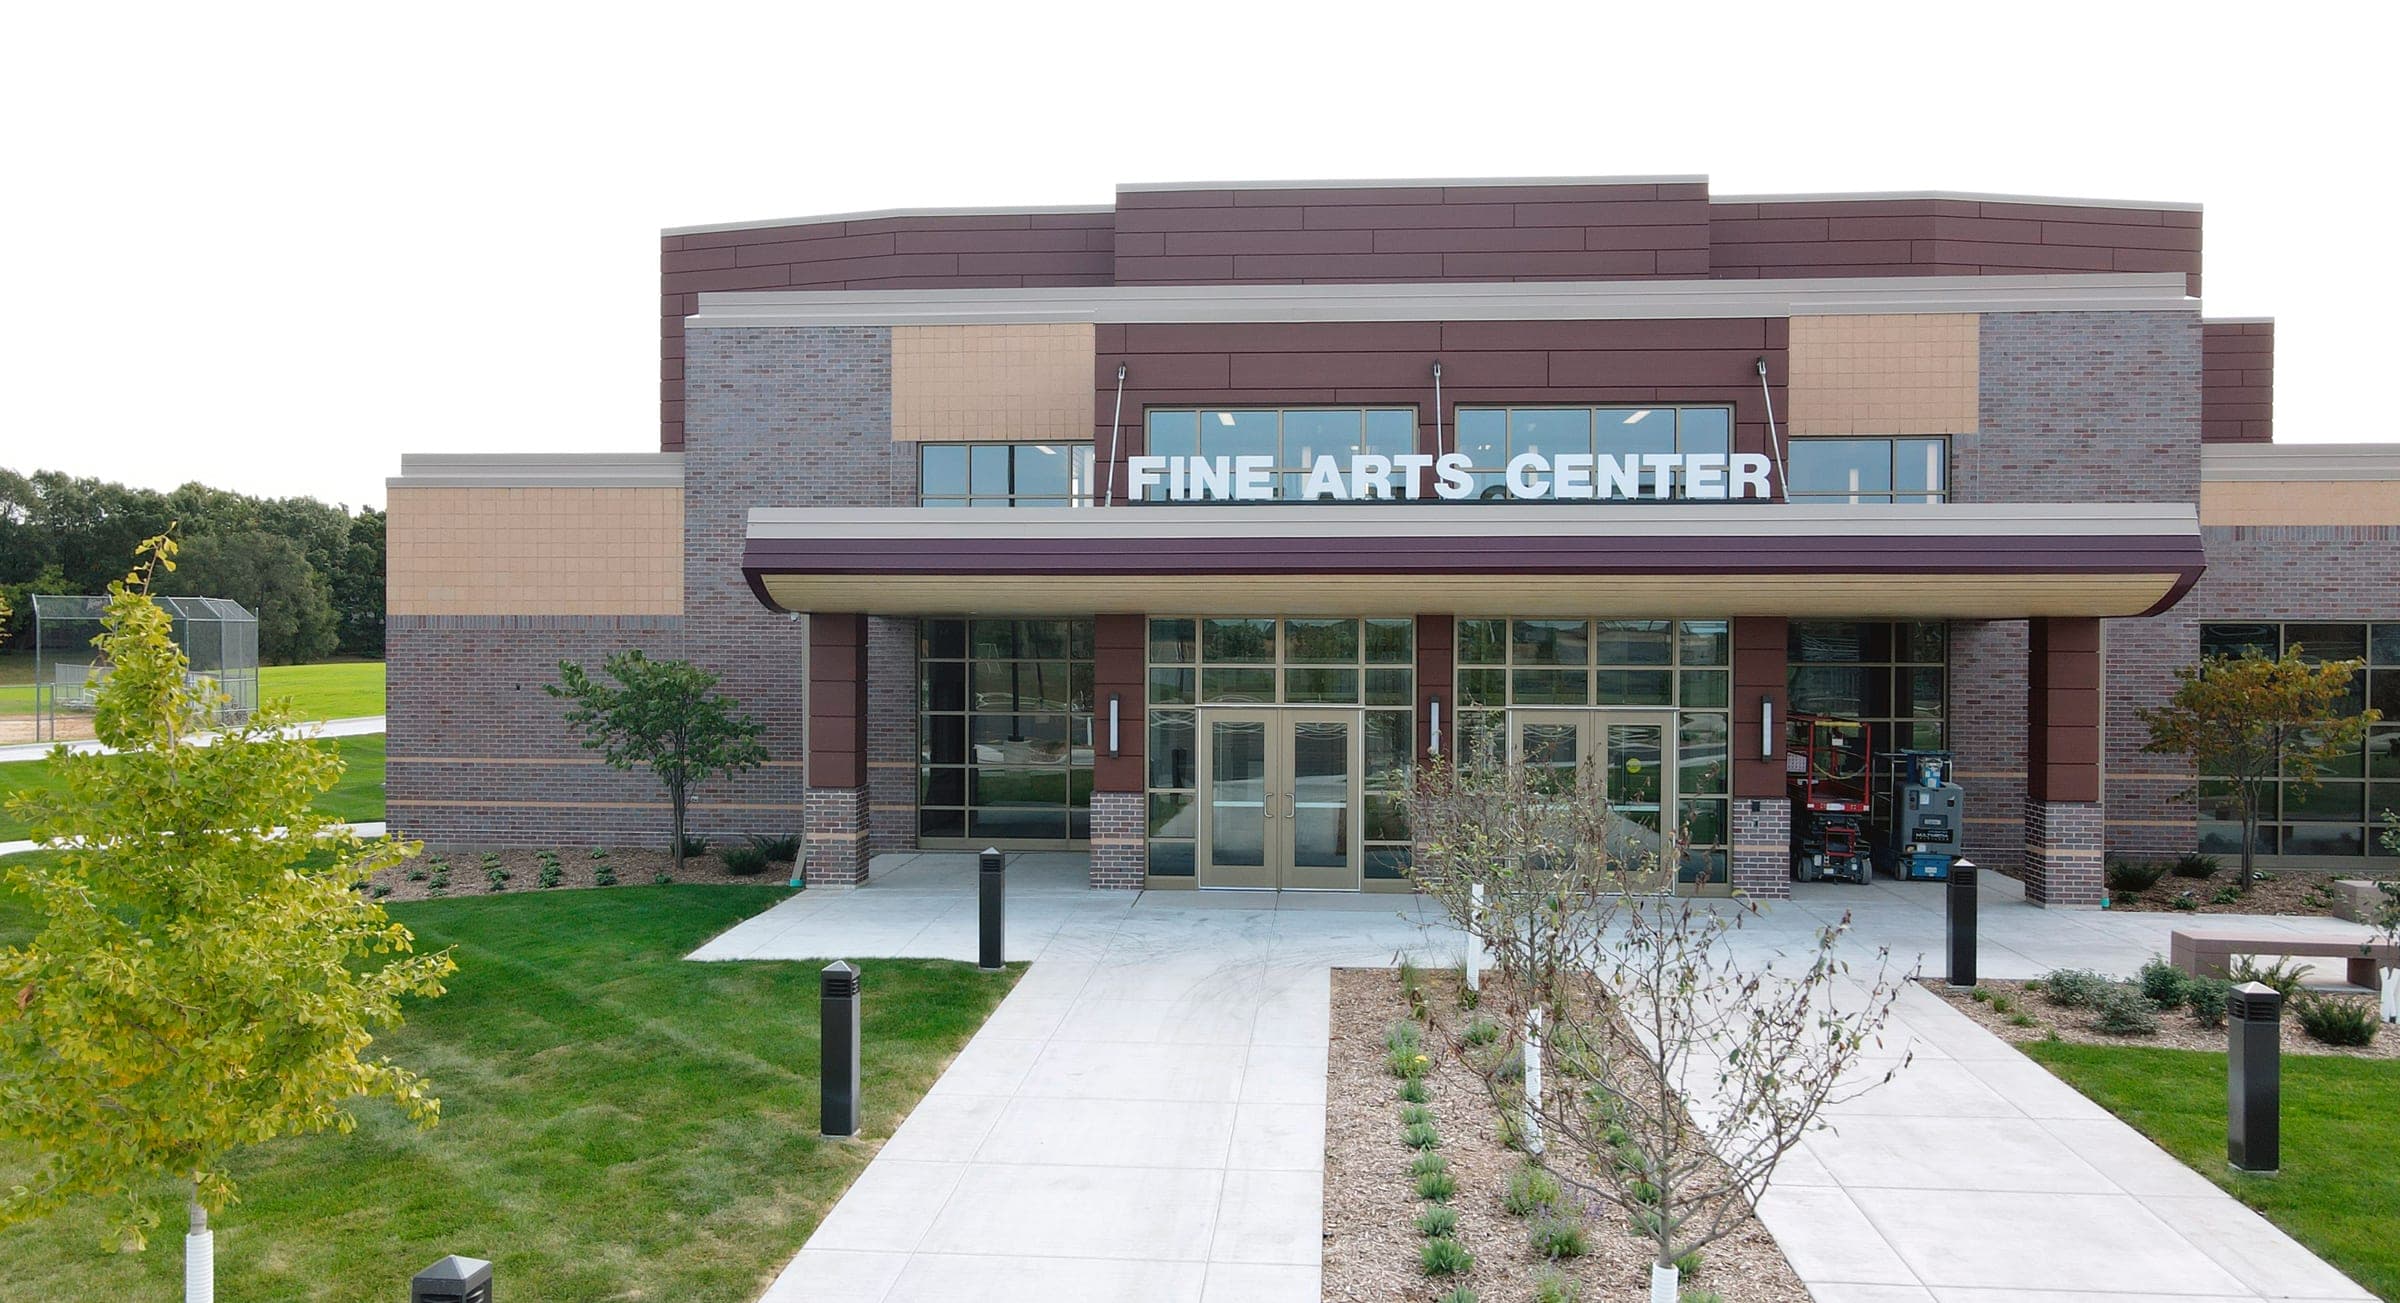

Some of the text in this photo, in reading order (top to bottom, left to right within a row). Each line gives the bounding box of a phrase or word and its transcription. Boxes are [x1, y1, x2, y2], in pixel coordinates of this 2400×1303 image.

[1128, 453, 1771, 500] FINE ARTS CENTER
